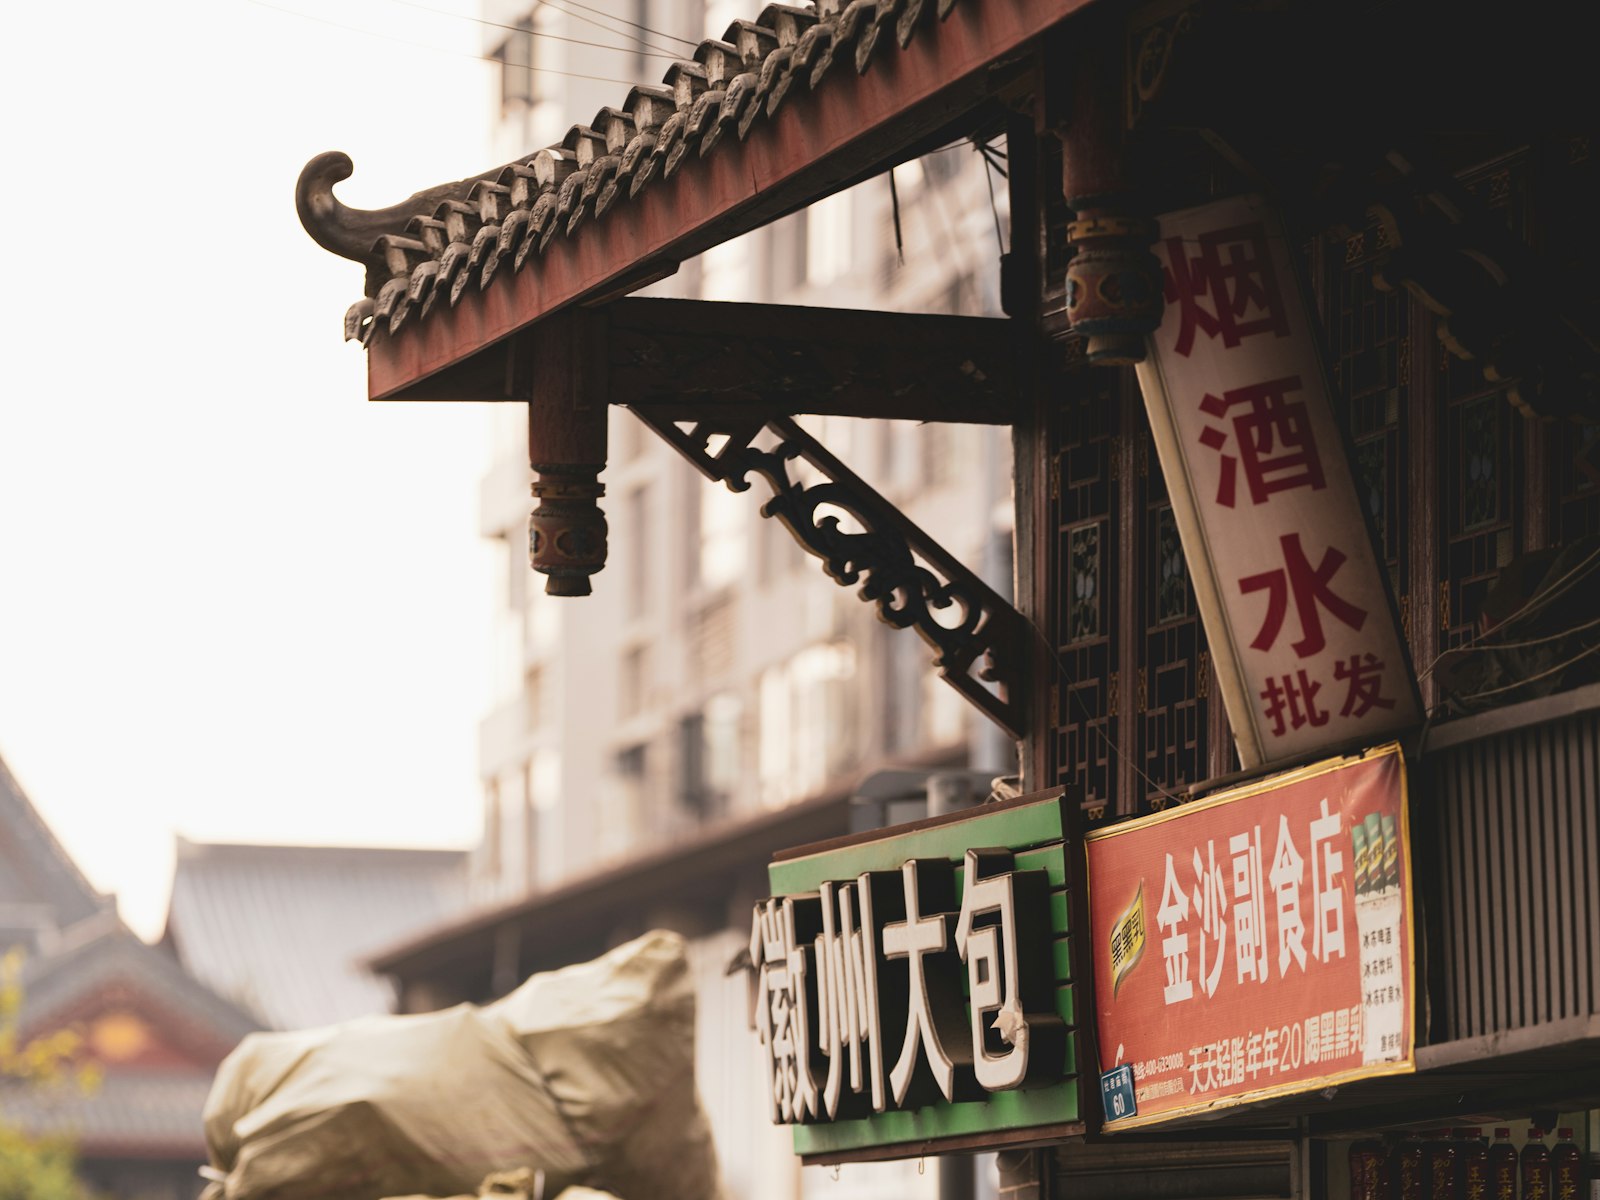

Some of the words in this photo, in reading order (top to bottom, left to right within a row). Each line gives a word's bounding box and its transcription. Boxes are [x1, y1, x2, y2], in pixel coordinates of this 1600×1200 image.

[1158, 221, 1368, 659] 烟酒水
[1260, 652, 1397, 738] 批发
[749, 848, 1030, 1124] 徽州大包
[1156, 798, 1346, 1006] 金沙副食店
[1112, 1092, 1126, 1116] 60
